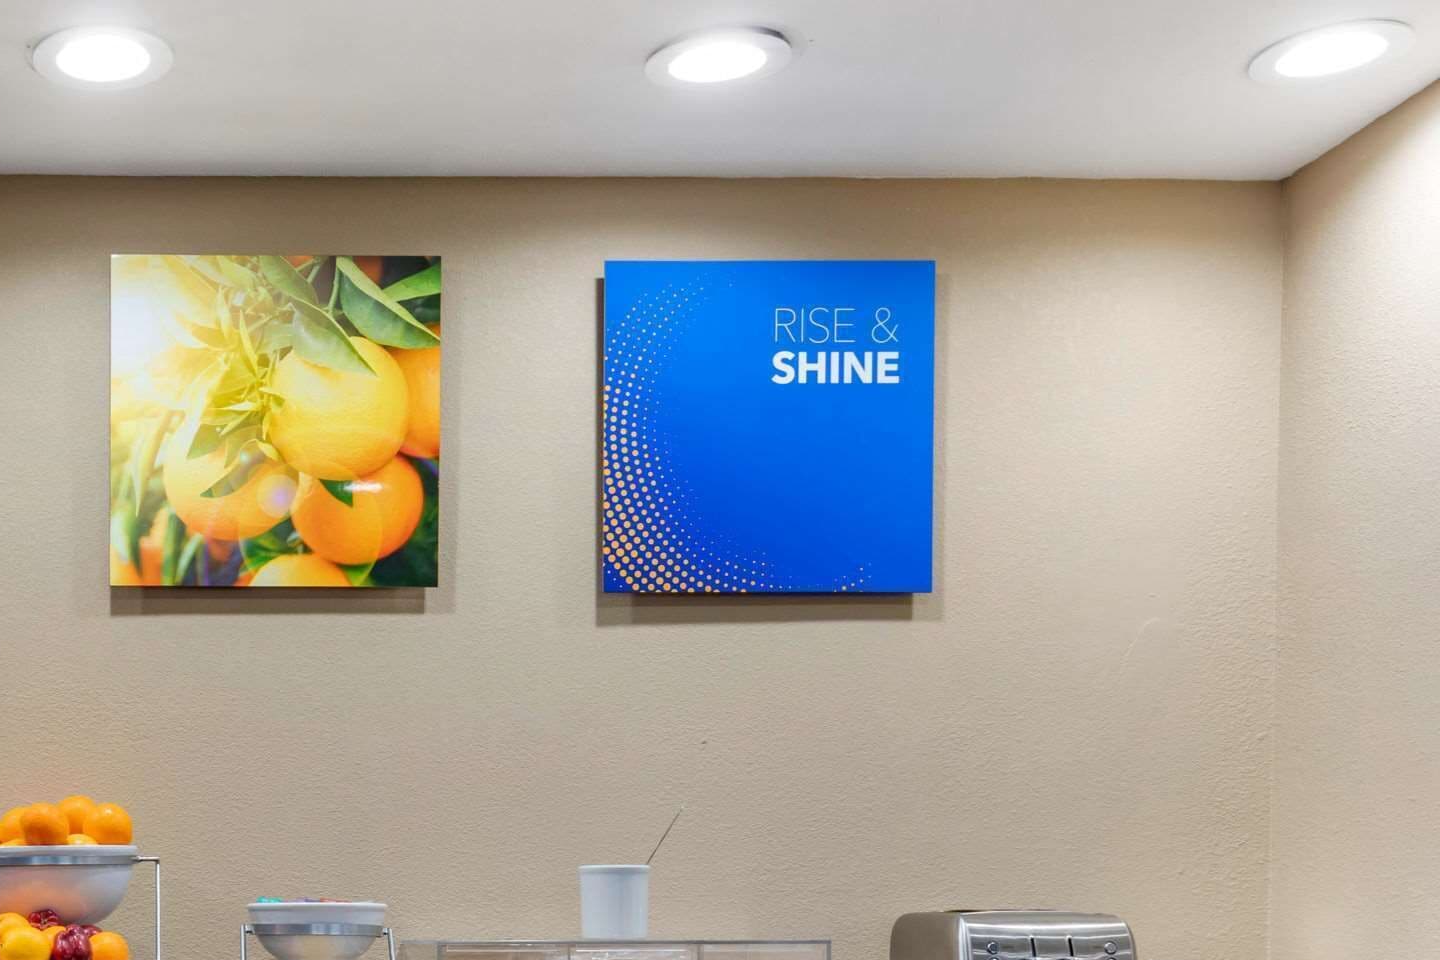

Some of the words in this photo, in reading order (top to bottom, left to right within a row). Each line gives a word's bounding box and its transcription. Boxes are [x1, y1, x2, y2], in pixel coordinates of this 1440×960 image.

[774, 307, 856, 344] RISE
[871, 307, 899, 344] &
[771, 350, 900, 384] SHINE
